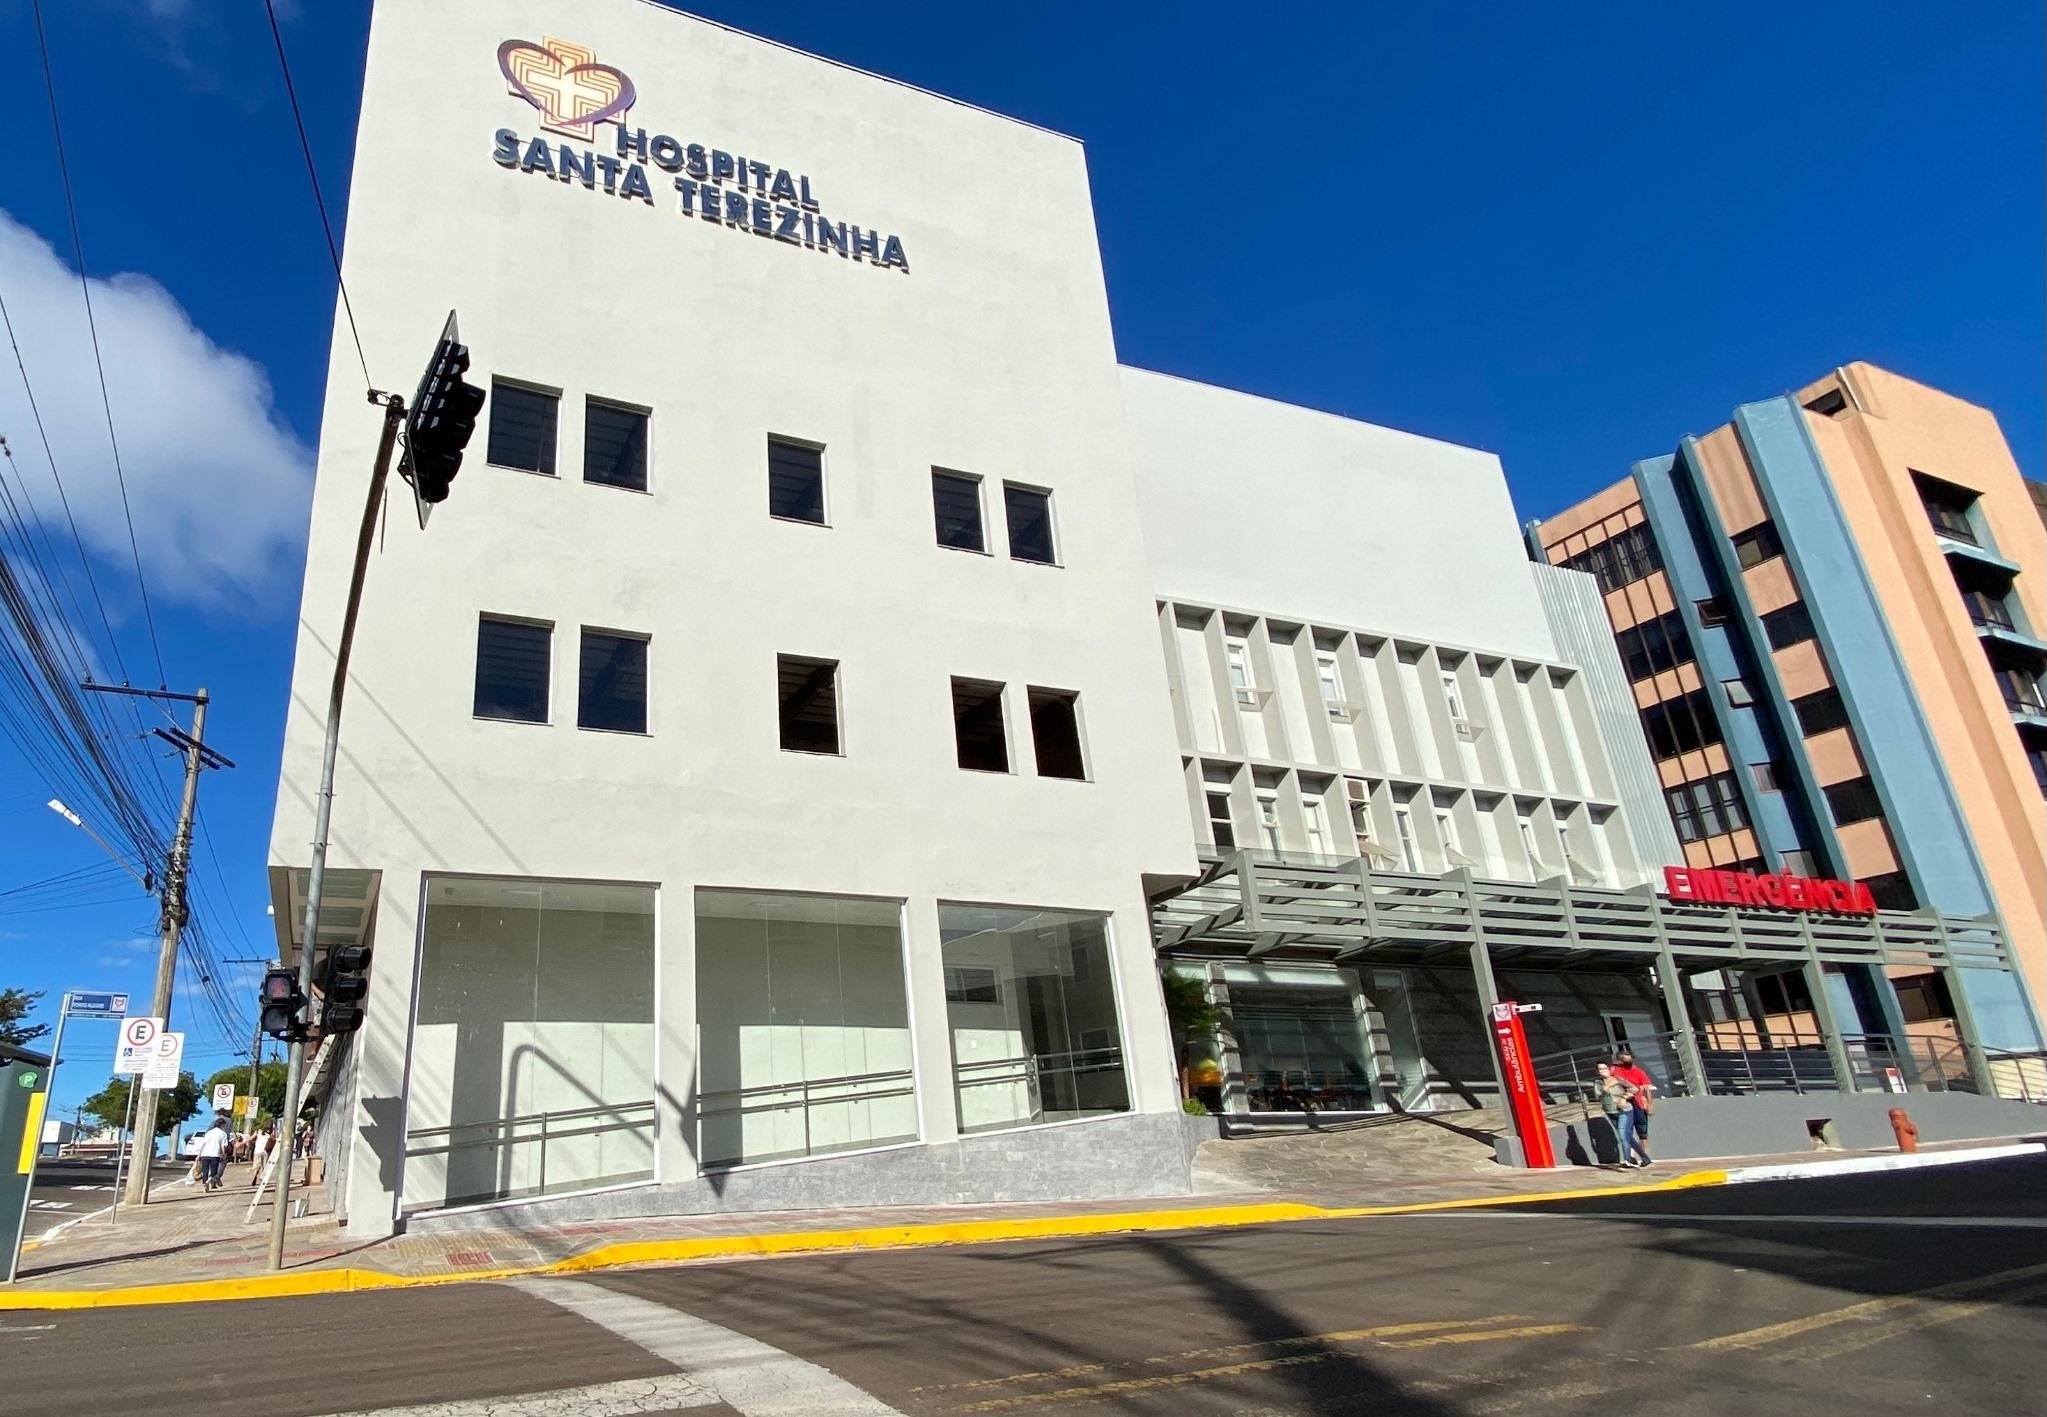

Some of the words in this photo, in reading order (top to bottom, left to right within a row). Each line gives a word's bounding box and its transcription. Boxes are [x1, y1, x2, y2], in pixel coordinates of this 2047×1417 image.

[617, 122, 819, 213] HOSPITAL
[493, 128, 655, 207] SANTA
[675, 177, 910, 275] TEREZINHA
[1664, 866, 1877, 916] EMERGÊNCIA
[135, 1025, 147, 1040] E
[161, 1039, 171, 1052] E
[24, 1075, 33, 1085] P
[1507, 1037, 1526, 1093] Ambulâncias
